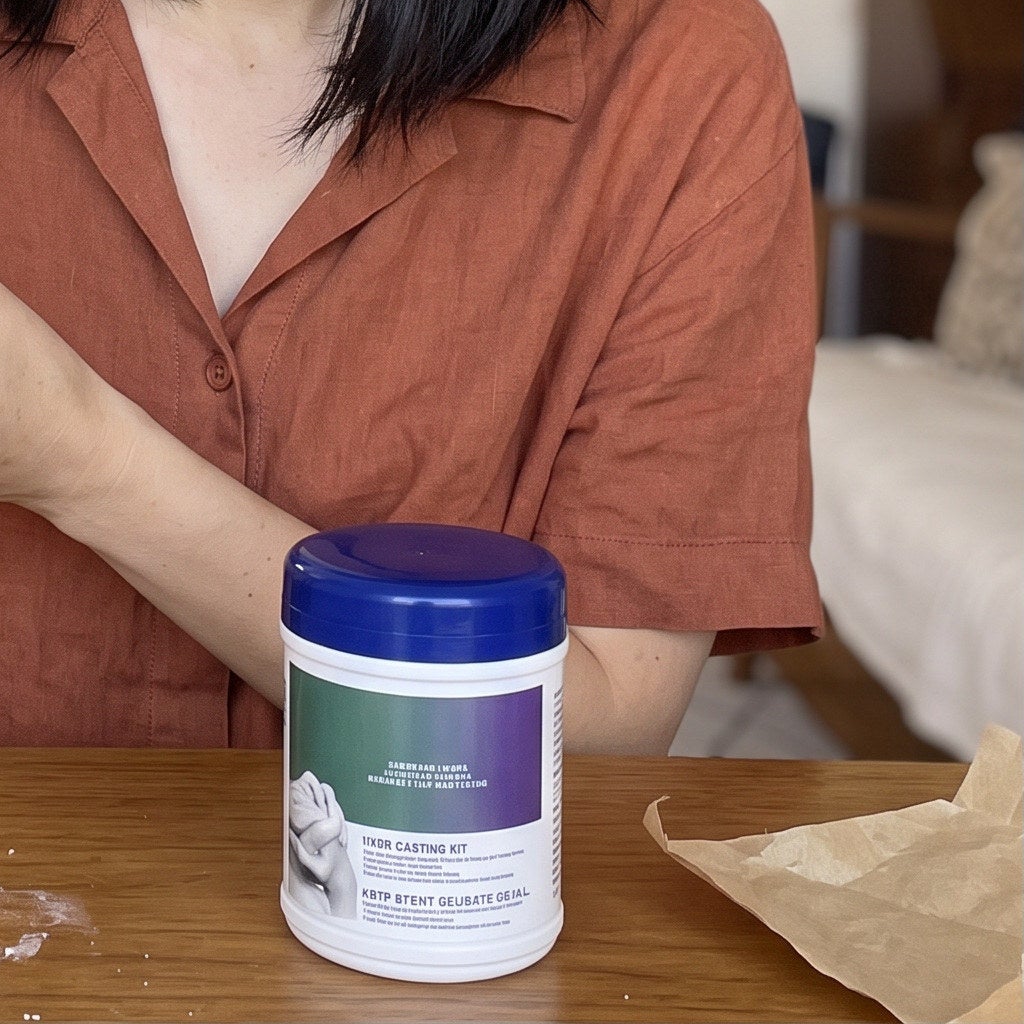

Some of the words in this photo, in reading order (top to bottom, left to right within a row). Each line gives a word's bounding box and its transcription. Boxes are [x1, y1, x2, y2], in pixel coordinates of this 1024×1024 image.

[395, 841, 446, 855] CASTING
[449, 843, 468, 854] KIT
[362, 888, 391, 902] KBTP
[395, 894, 435, 906] BTENT
